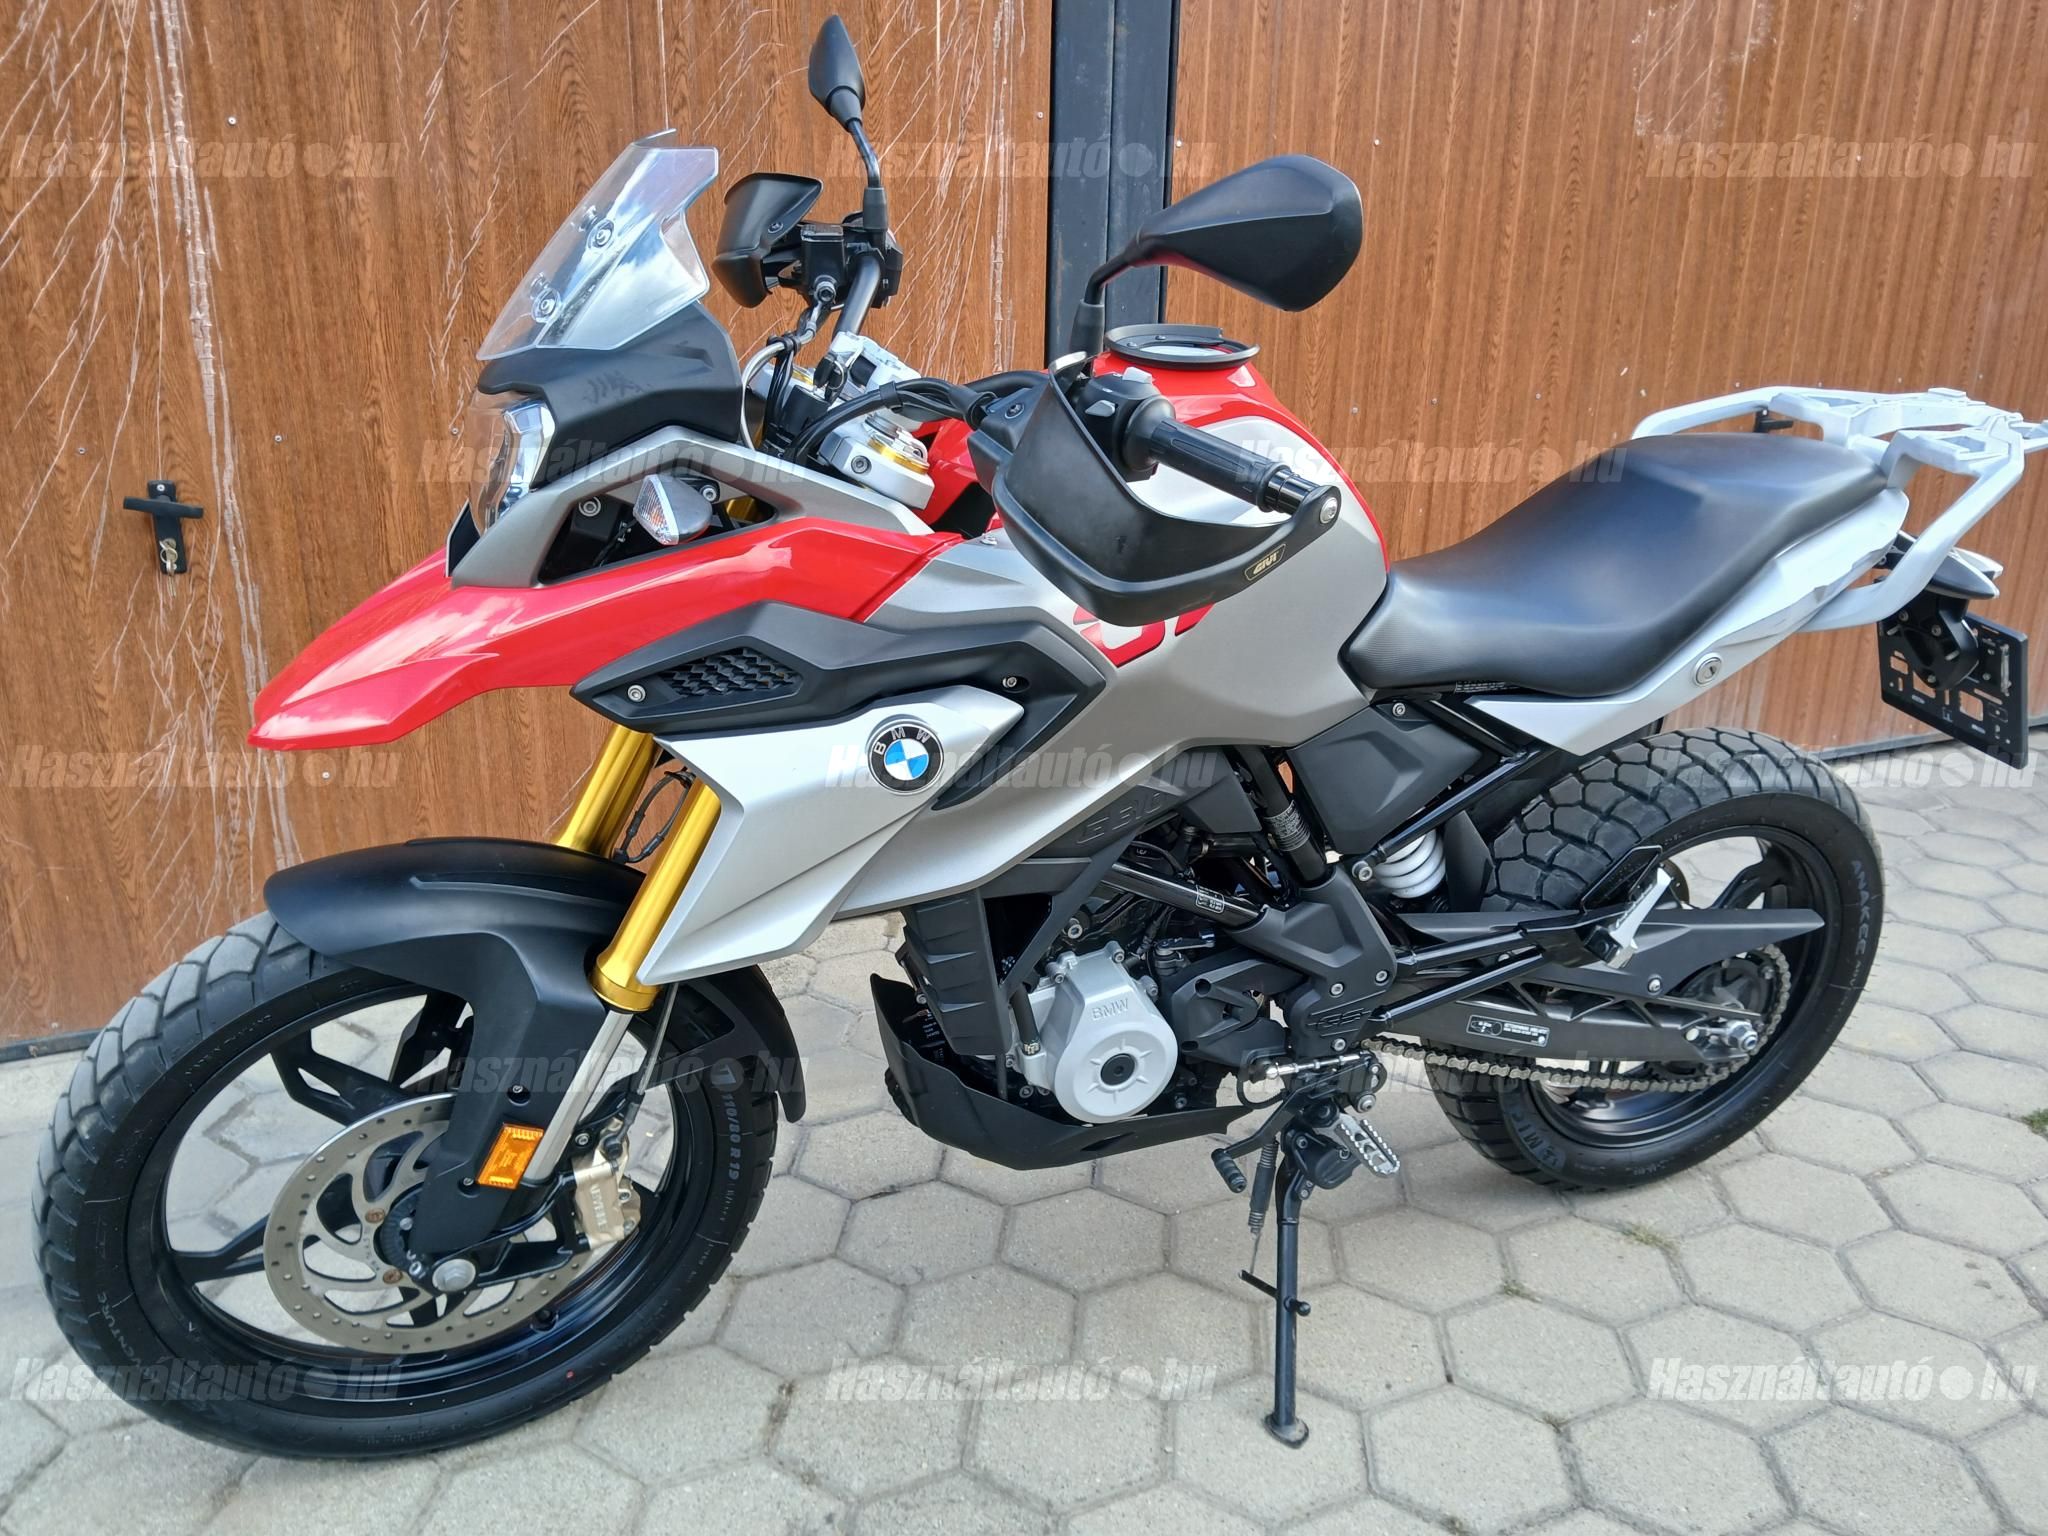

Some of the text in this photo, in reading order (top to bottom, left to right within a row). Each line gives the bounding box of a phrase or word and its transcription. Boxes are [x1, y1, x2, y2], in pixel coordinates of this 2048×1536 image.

[1253, 552, 1278, 574] GIVI
[874, 726, 931, 756] BMW
[1091, 998, 1130, 1021] BMW
